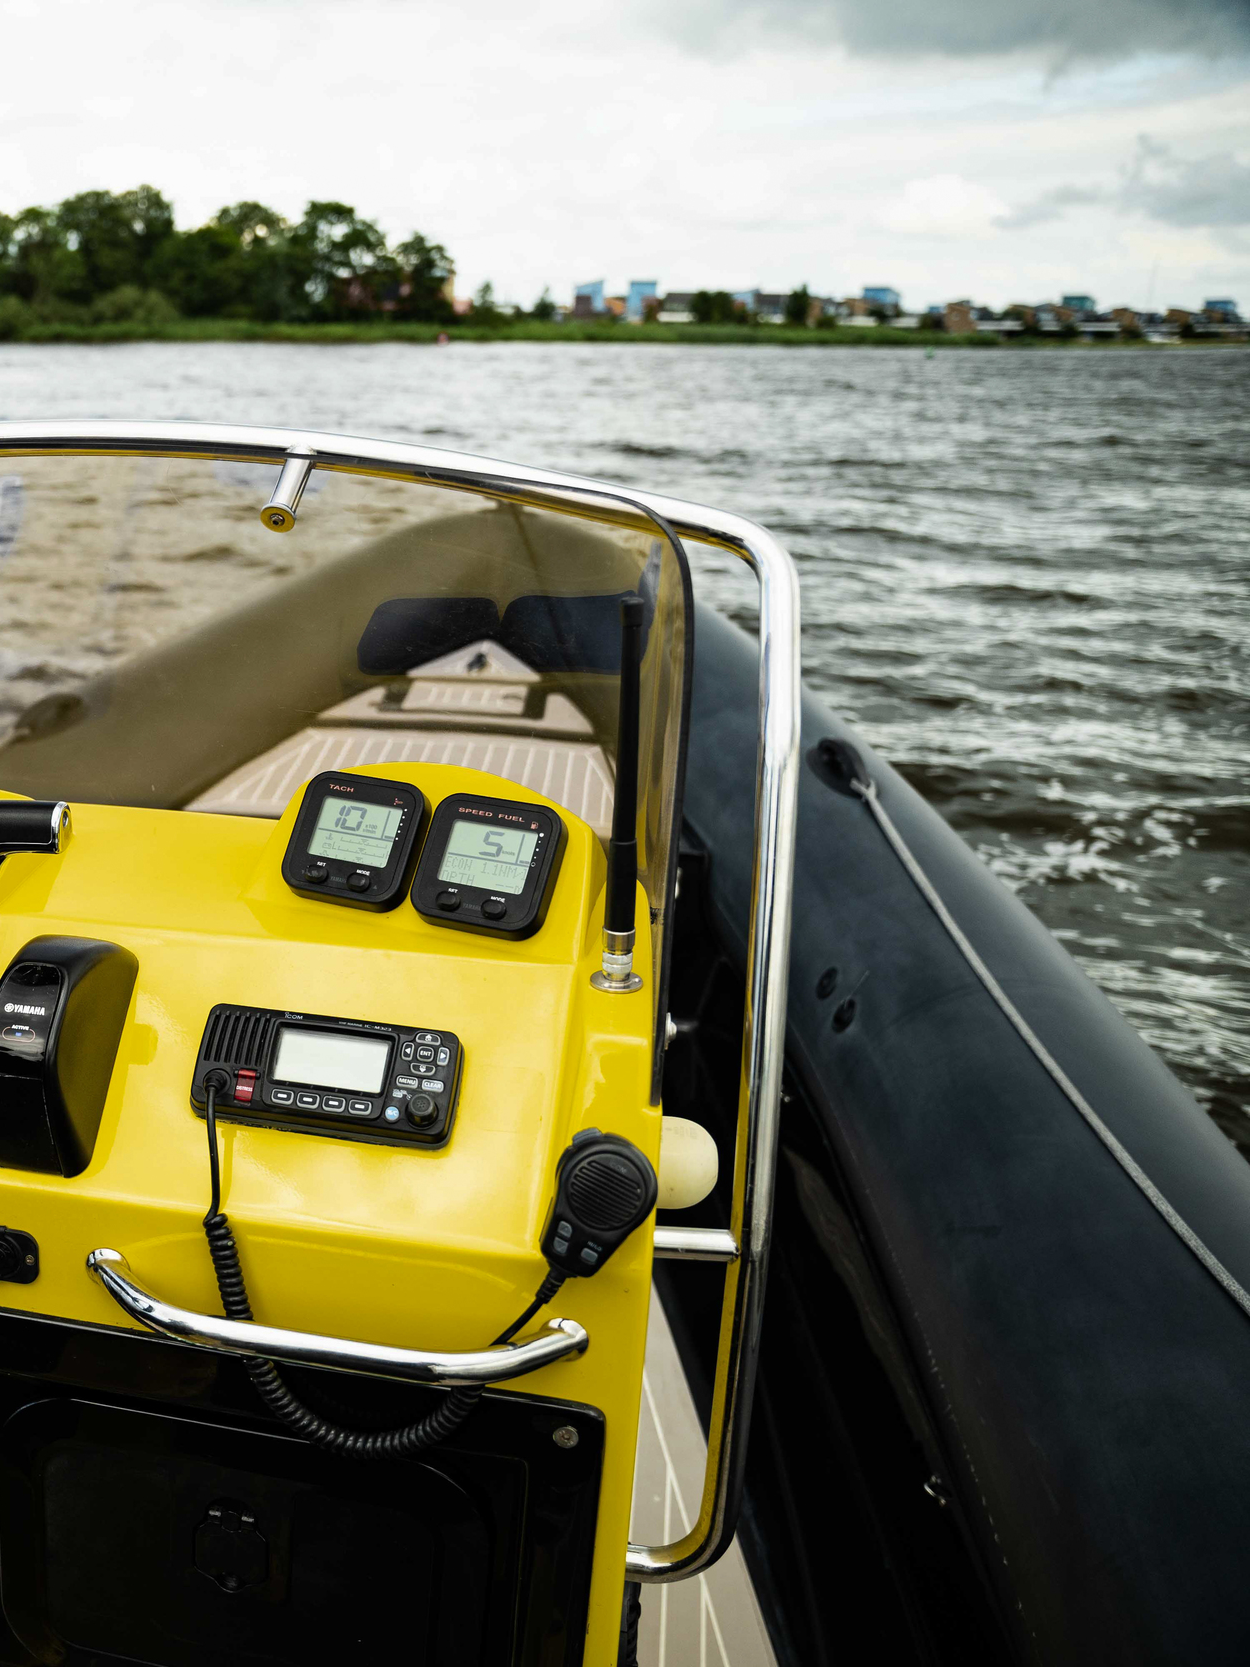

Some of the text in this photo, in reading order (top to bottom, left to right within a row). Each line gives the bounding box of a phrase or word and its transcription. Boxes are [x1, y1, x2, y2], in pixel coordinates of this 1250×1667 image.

[329, 783, 354, 793] TACH
[334, 805, 368, 832] 10
[458, 807, 525, 823] SPEED FUEL
[478, 830, 505, 858] 5
[445, 856, 473, 871] ECON
[14, 1004, 45, 1016] YAMAHA
[398, 1077, 416, 1085] MENU
[424, 1081, 442, 1089] CLEAR
